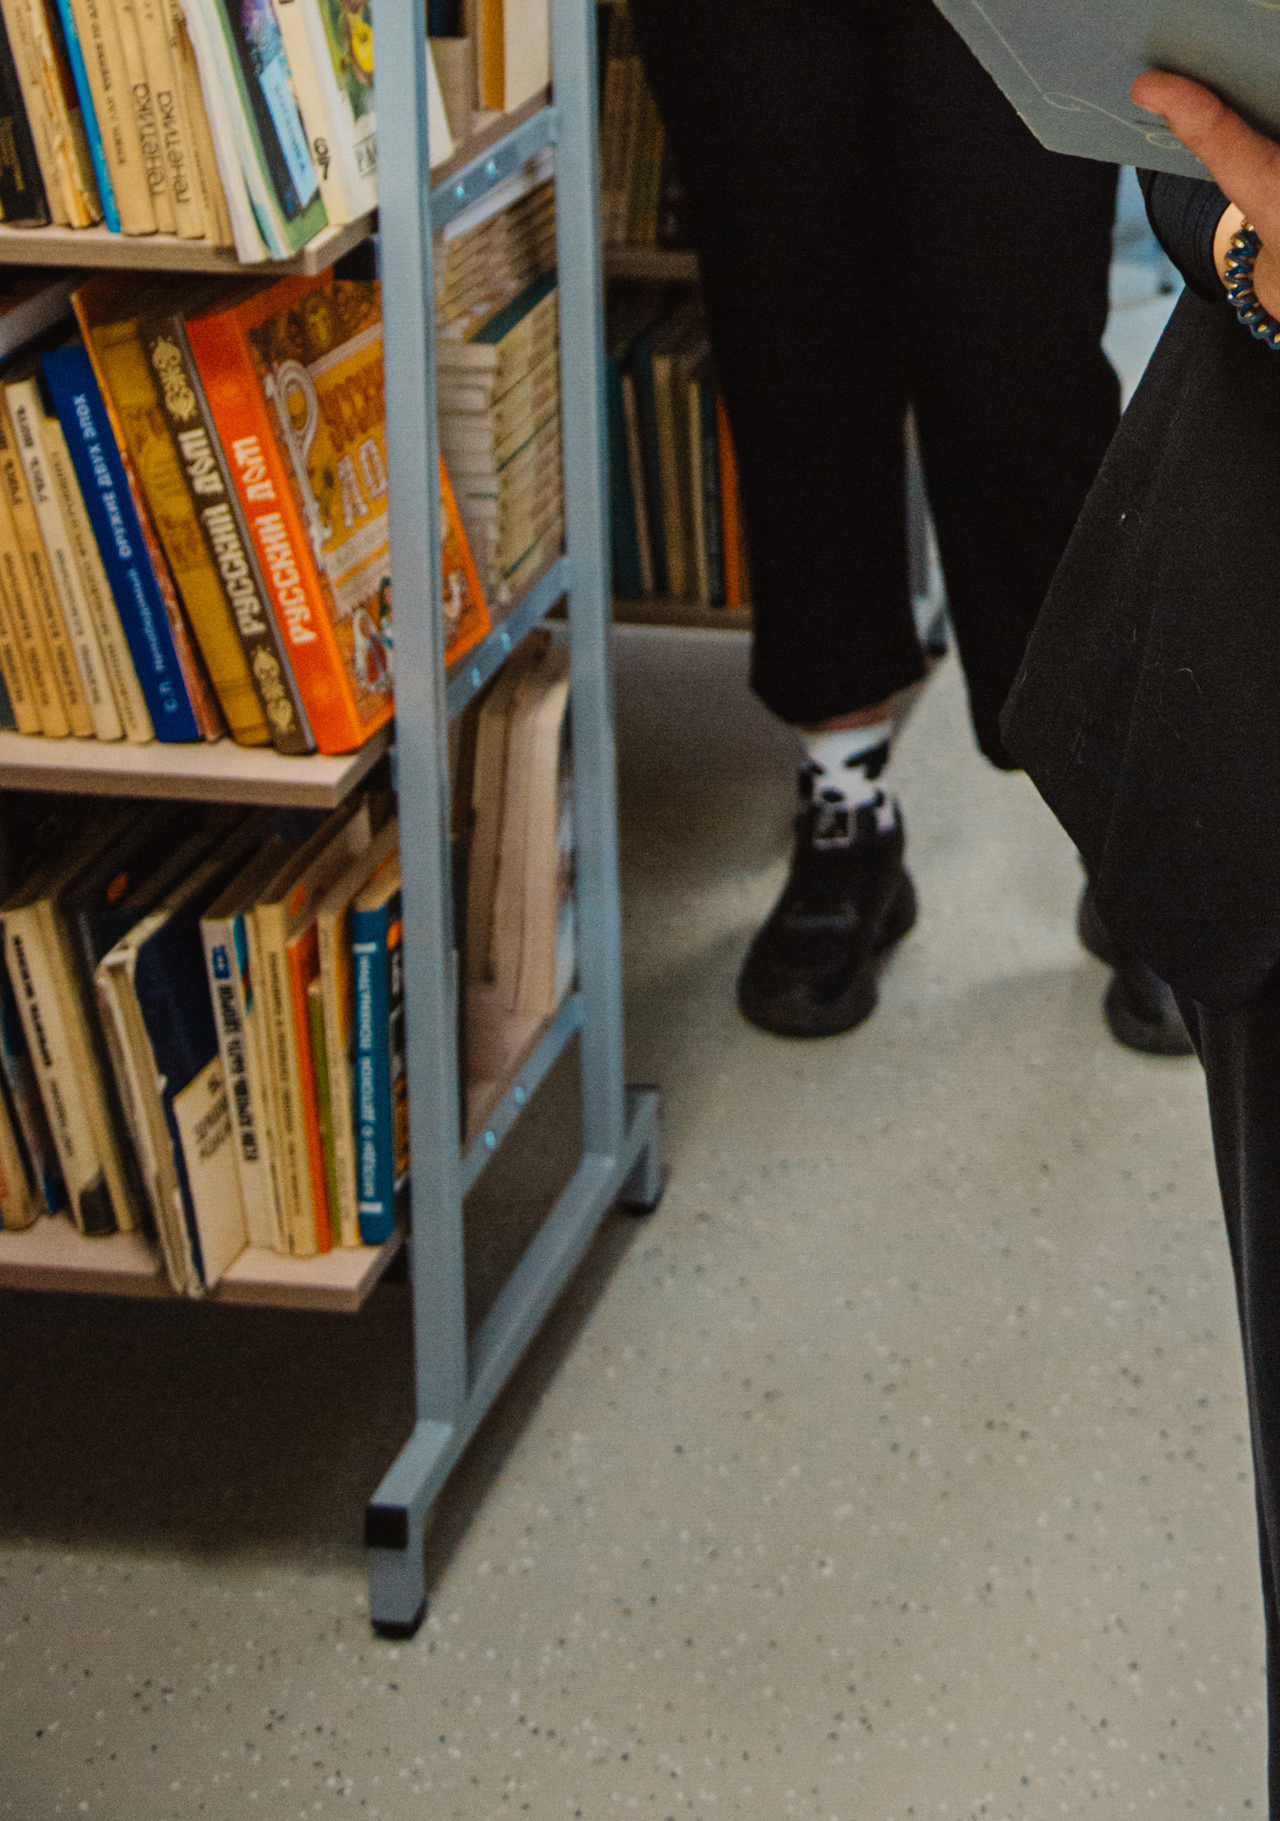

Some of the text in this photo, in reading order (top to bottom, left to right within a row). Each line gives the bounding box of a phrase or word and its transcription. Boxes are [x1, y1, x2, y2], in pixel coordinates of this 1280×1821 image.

[72, 393, 98, 441] ЭПОХ
[87, 442, 111, 488] ДВУХ
[101, 490, 133, 560] ОРУЖИЕ
[173, 424, 271, 637] РУССКИЙ ДОМ
[228, 433, 321, 647] РУССКИЙ ДОМ
